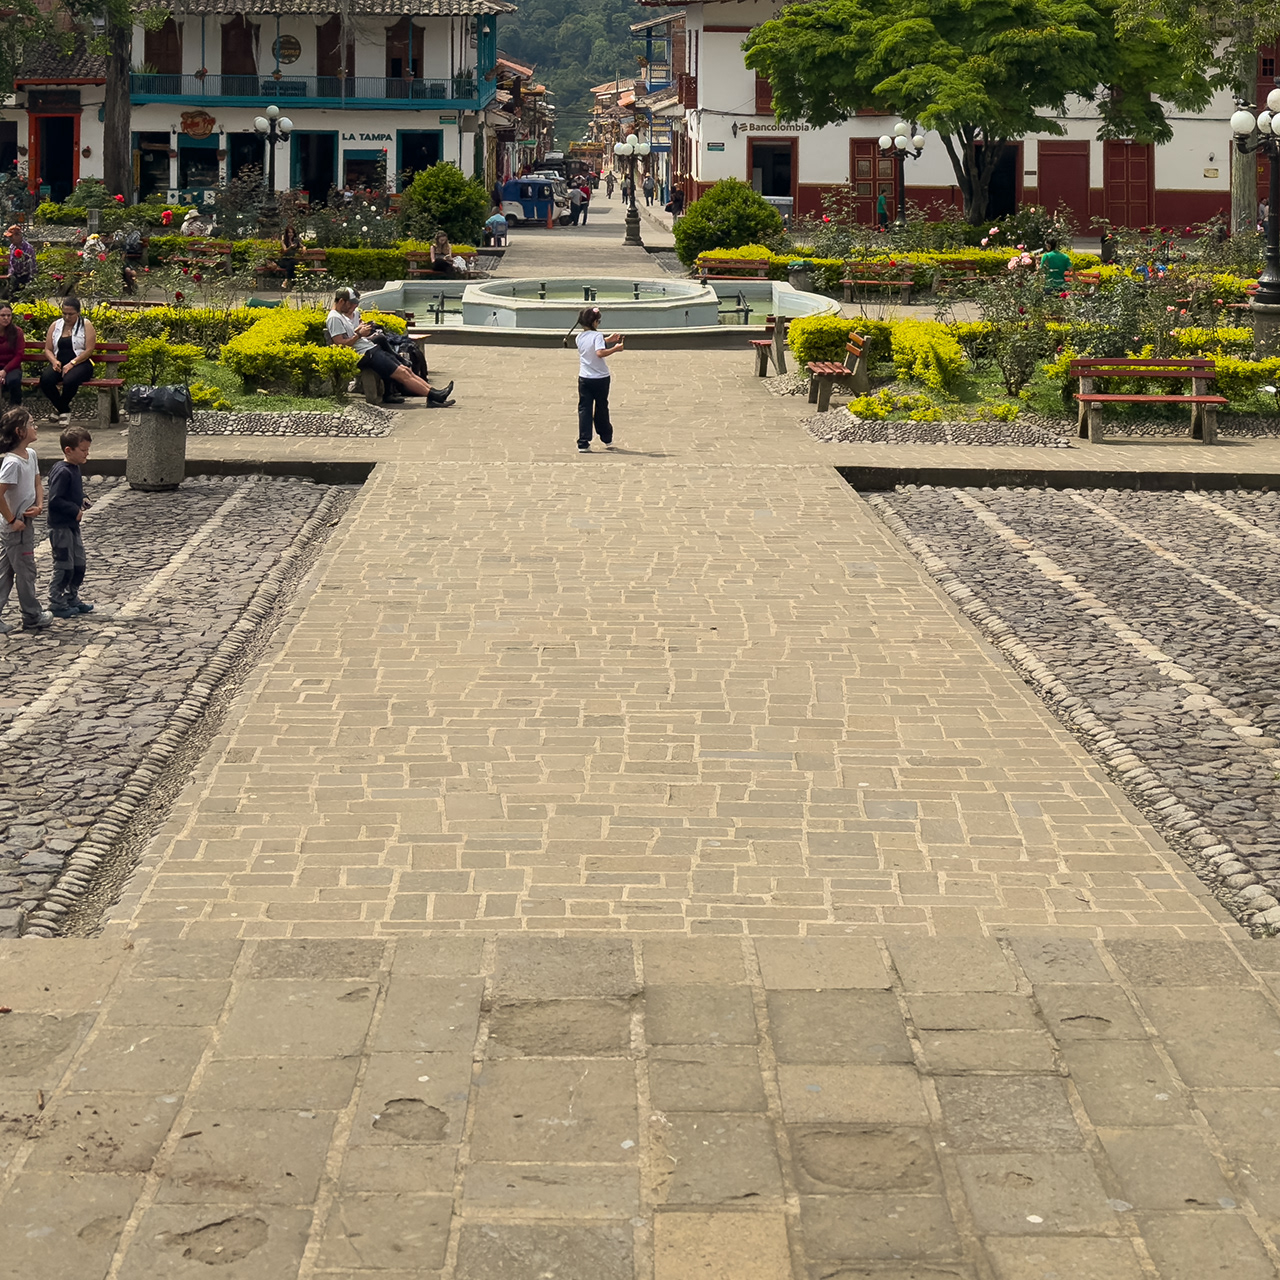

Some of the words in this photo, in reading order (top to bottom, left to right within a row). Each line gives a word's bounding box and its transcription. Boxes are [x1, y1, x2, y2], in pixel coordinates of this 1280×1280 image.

[749, 122, 809, 131] Bancolombia
[342, 133, 356, 141] LA
[359, 133, 393, 141] TAMPA
